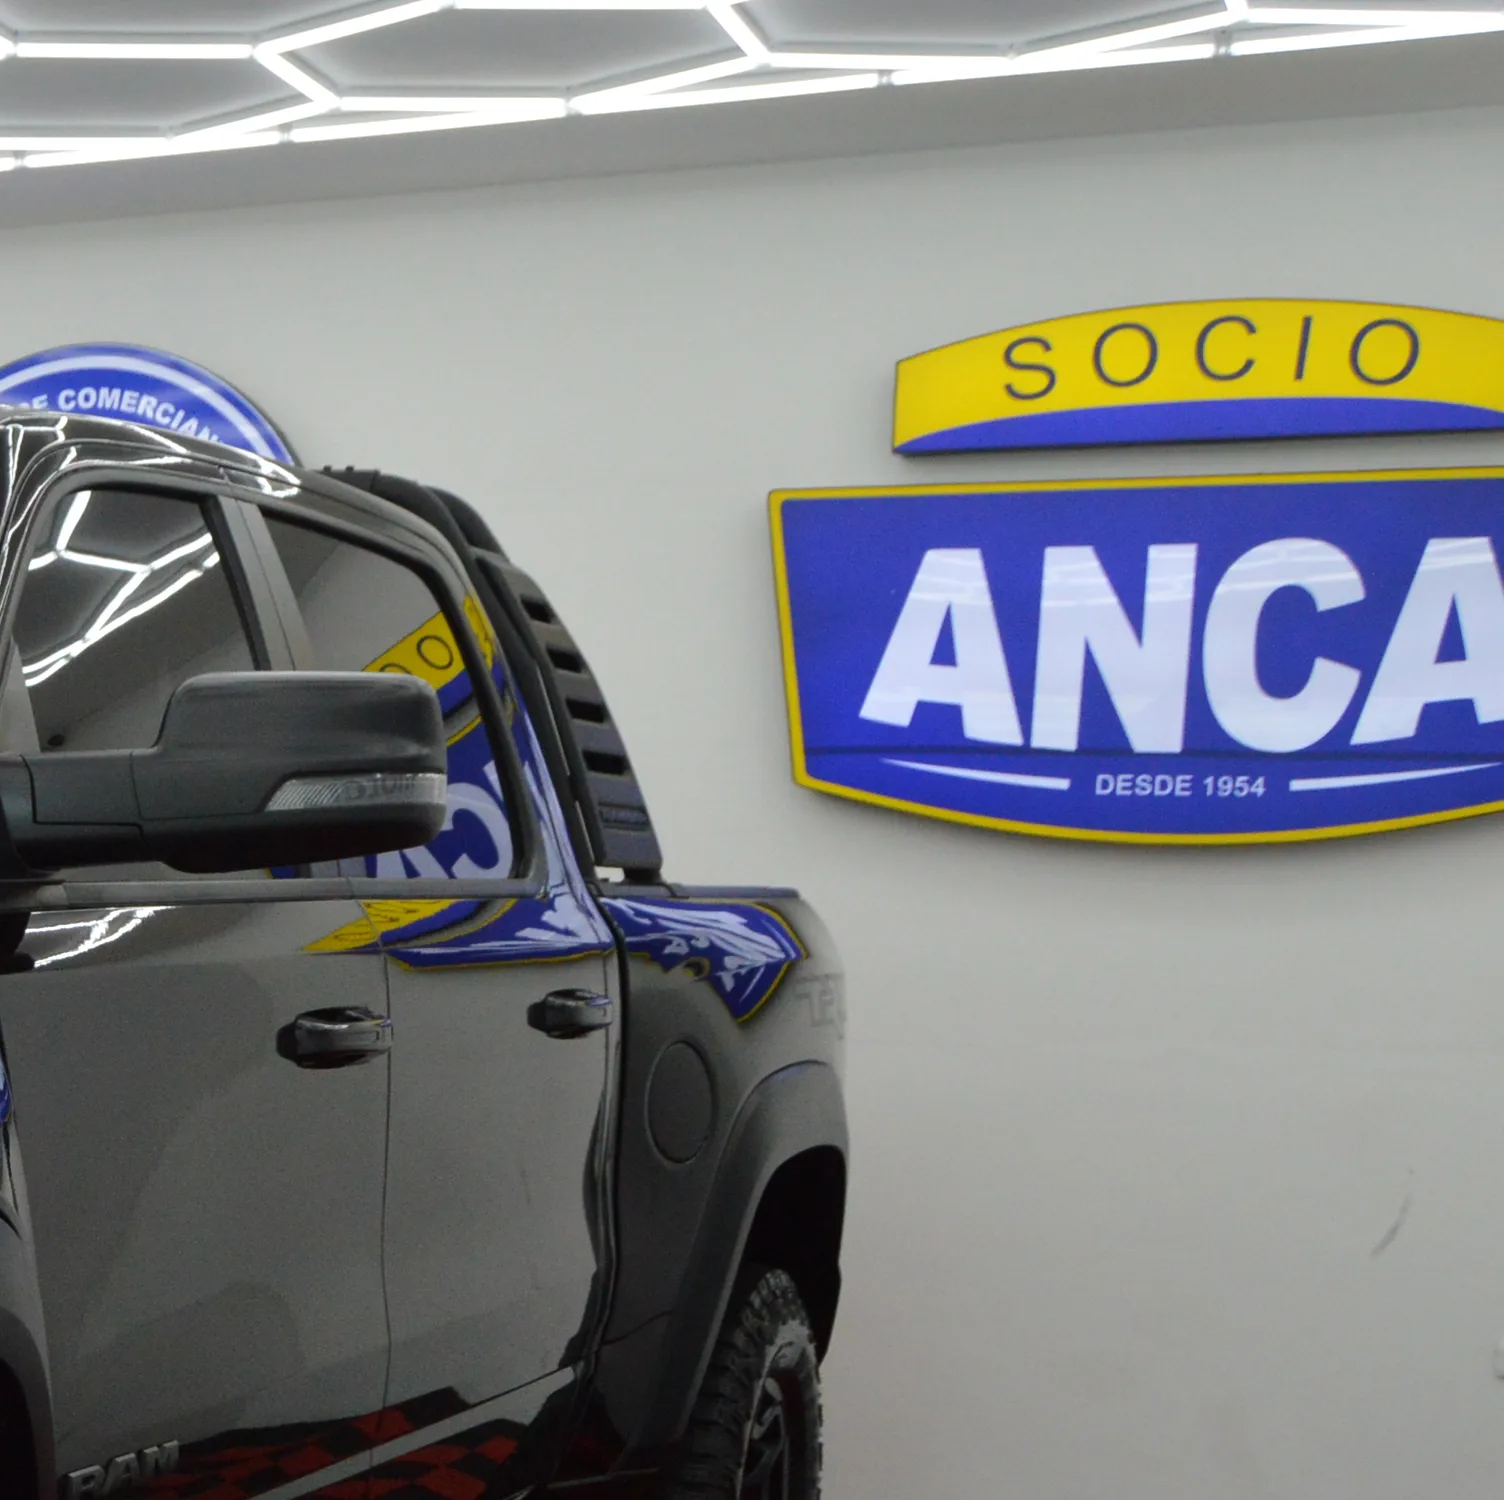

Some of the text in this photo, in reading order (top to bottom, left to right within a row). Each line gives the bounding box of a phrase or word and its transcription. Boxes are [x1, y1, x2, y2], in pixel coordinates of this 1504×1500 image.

[1002, 315, 1421, 401] SOCIO
[858, 537, 1504, 755] ANCA
[1095, 774, 1267, 798] DESDE 1954
